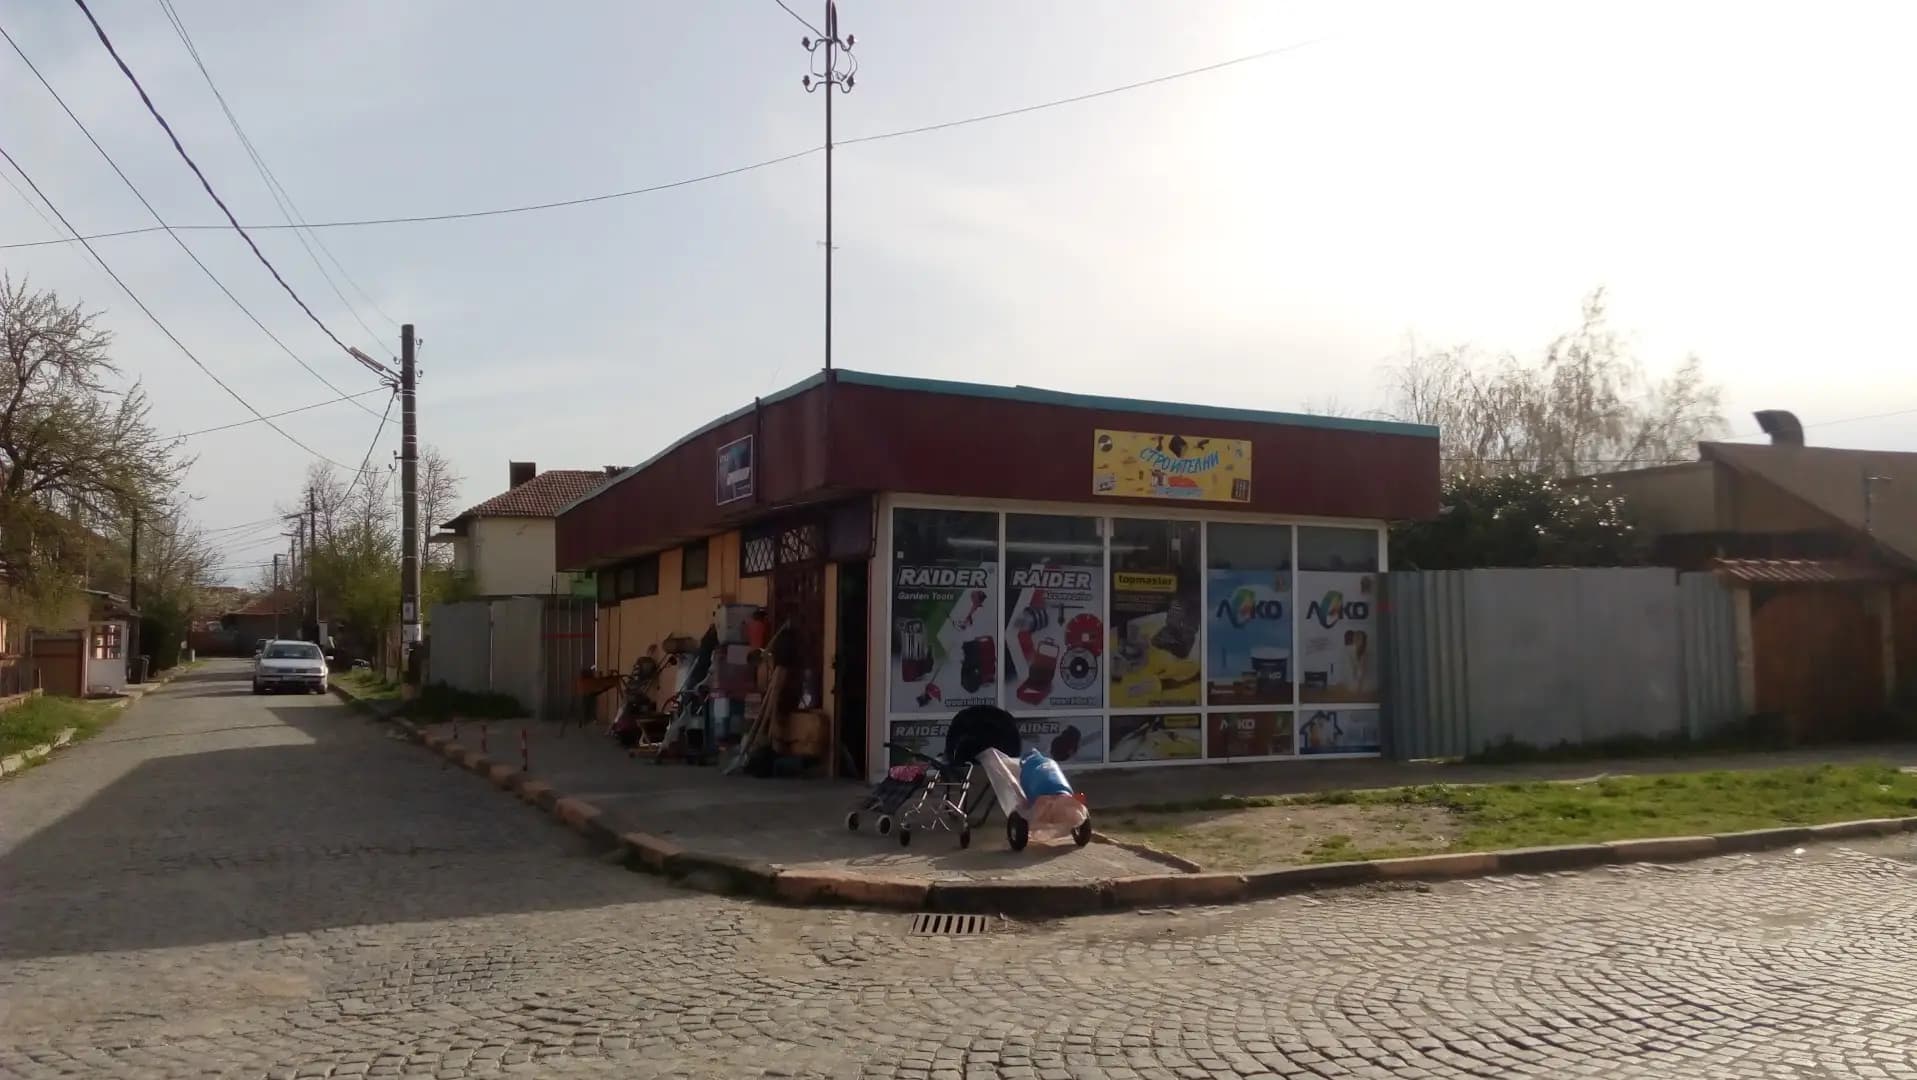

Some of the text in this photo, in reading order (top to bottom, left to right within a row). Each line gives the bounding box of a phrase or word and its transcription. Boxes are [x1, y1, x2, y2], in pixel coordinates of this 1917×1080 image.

[1139, 448, 1220, 474] СТРОИТЕЛНИ
[898, 568, 987, 587] RAIDER
[1012, 570, 1091, 589] RAIDER
[1018, 722, 1059, 734] AIDER
